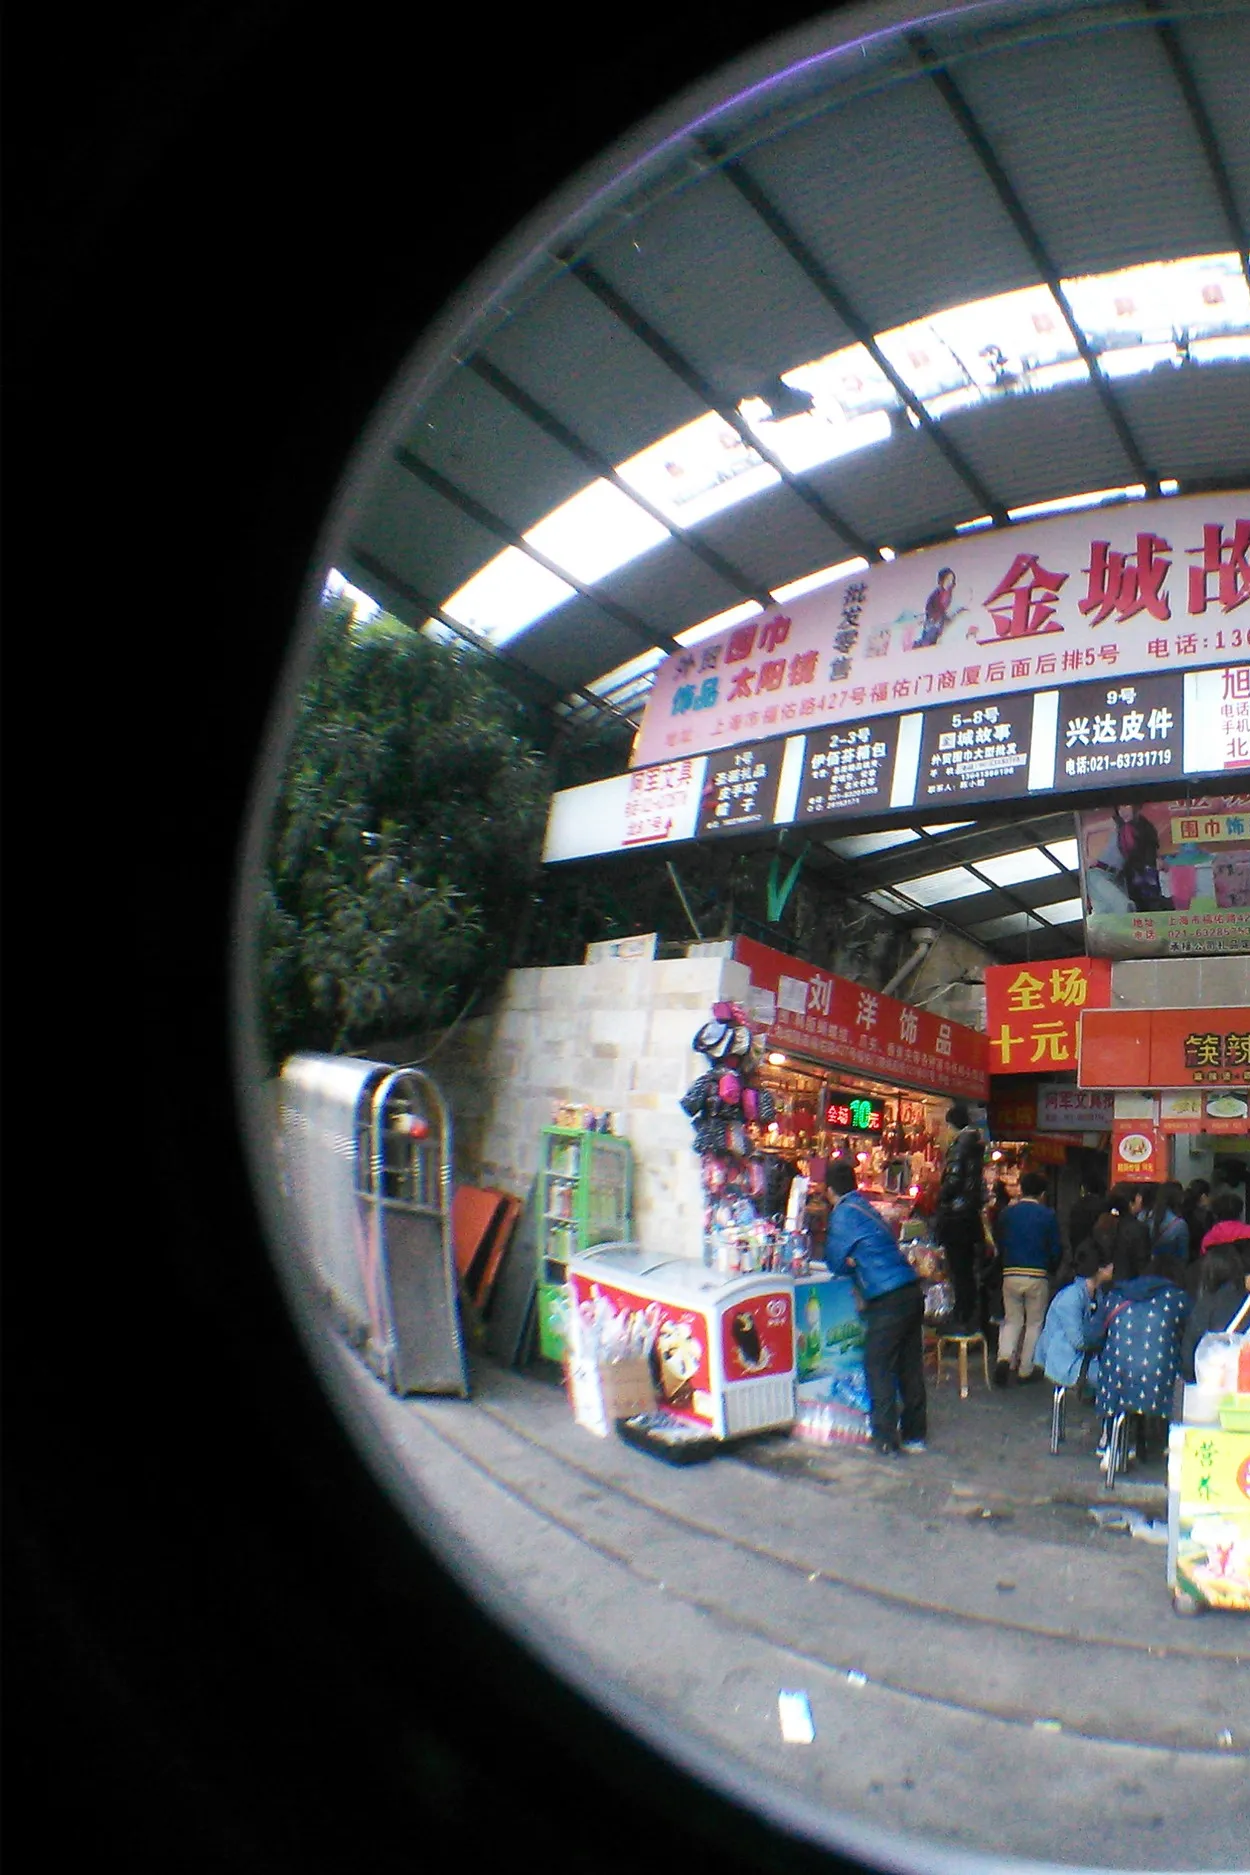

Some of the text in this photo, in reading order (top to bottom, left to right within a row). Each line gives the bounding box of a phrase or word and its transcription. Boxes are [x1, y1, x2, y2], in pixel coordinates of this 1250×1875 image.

[952, 706, 1000, 728] 5-8号
[1106, 687, 1136, 705] 9号
[1065, 707, 1173, 748] 兴达皮件
[1007, 967, 1088, 1012] 全场
[808, 973, 952, 1056] 刘洋饰品
[990, 1020, 1080, 1064] 十元
